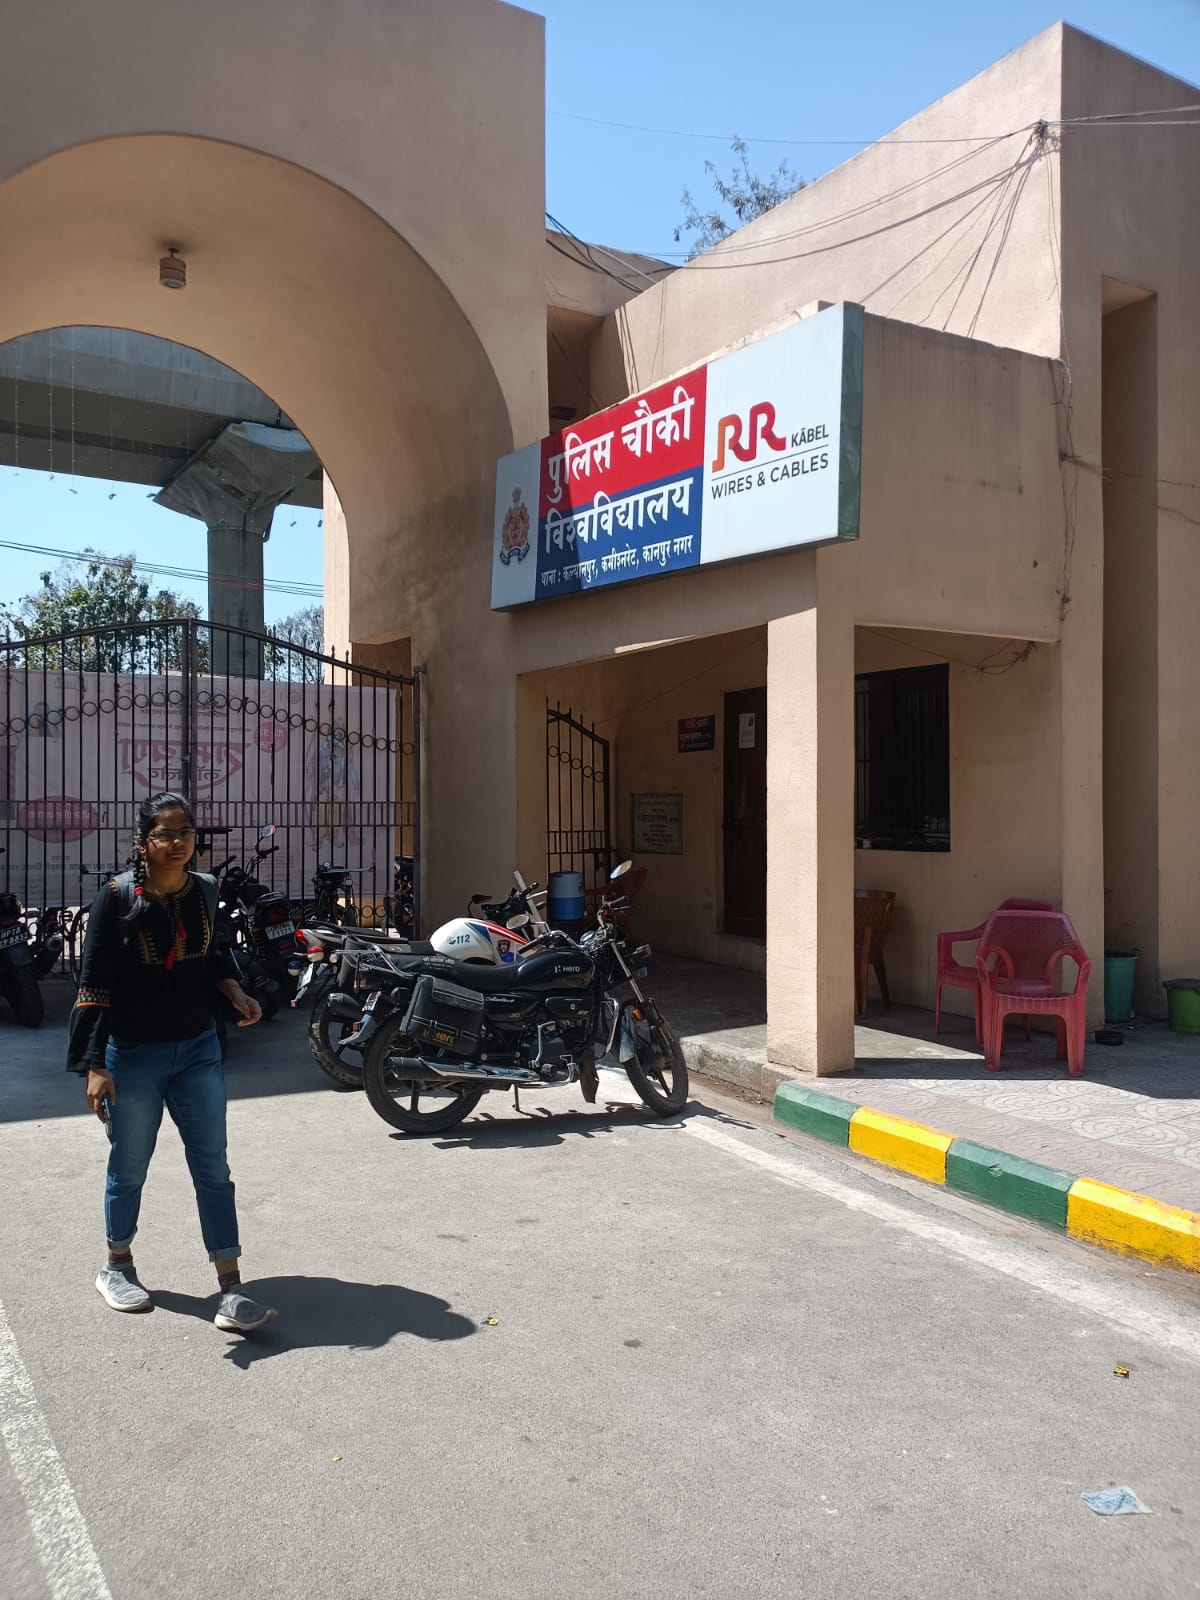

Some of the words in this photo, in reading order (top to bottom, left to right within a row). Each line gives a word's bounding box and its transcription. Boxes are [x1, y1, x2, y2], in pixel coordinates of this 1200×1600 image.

[546, 432, 615, 504] पुलिस
[621, 385, 695, 458] चौकी
[711, 475, 753, 500] WIRES
[756, 471, 766, 488] &
[770, 453, 829, 483] CABLES
[544, 477, 694, 553] विश्वविद्यालय
[642, 540, 672, 566] कानपुर
[673, 534, 694, 557] नगर
[456, 934, 471, 945] 112
